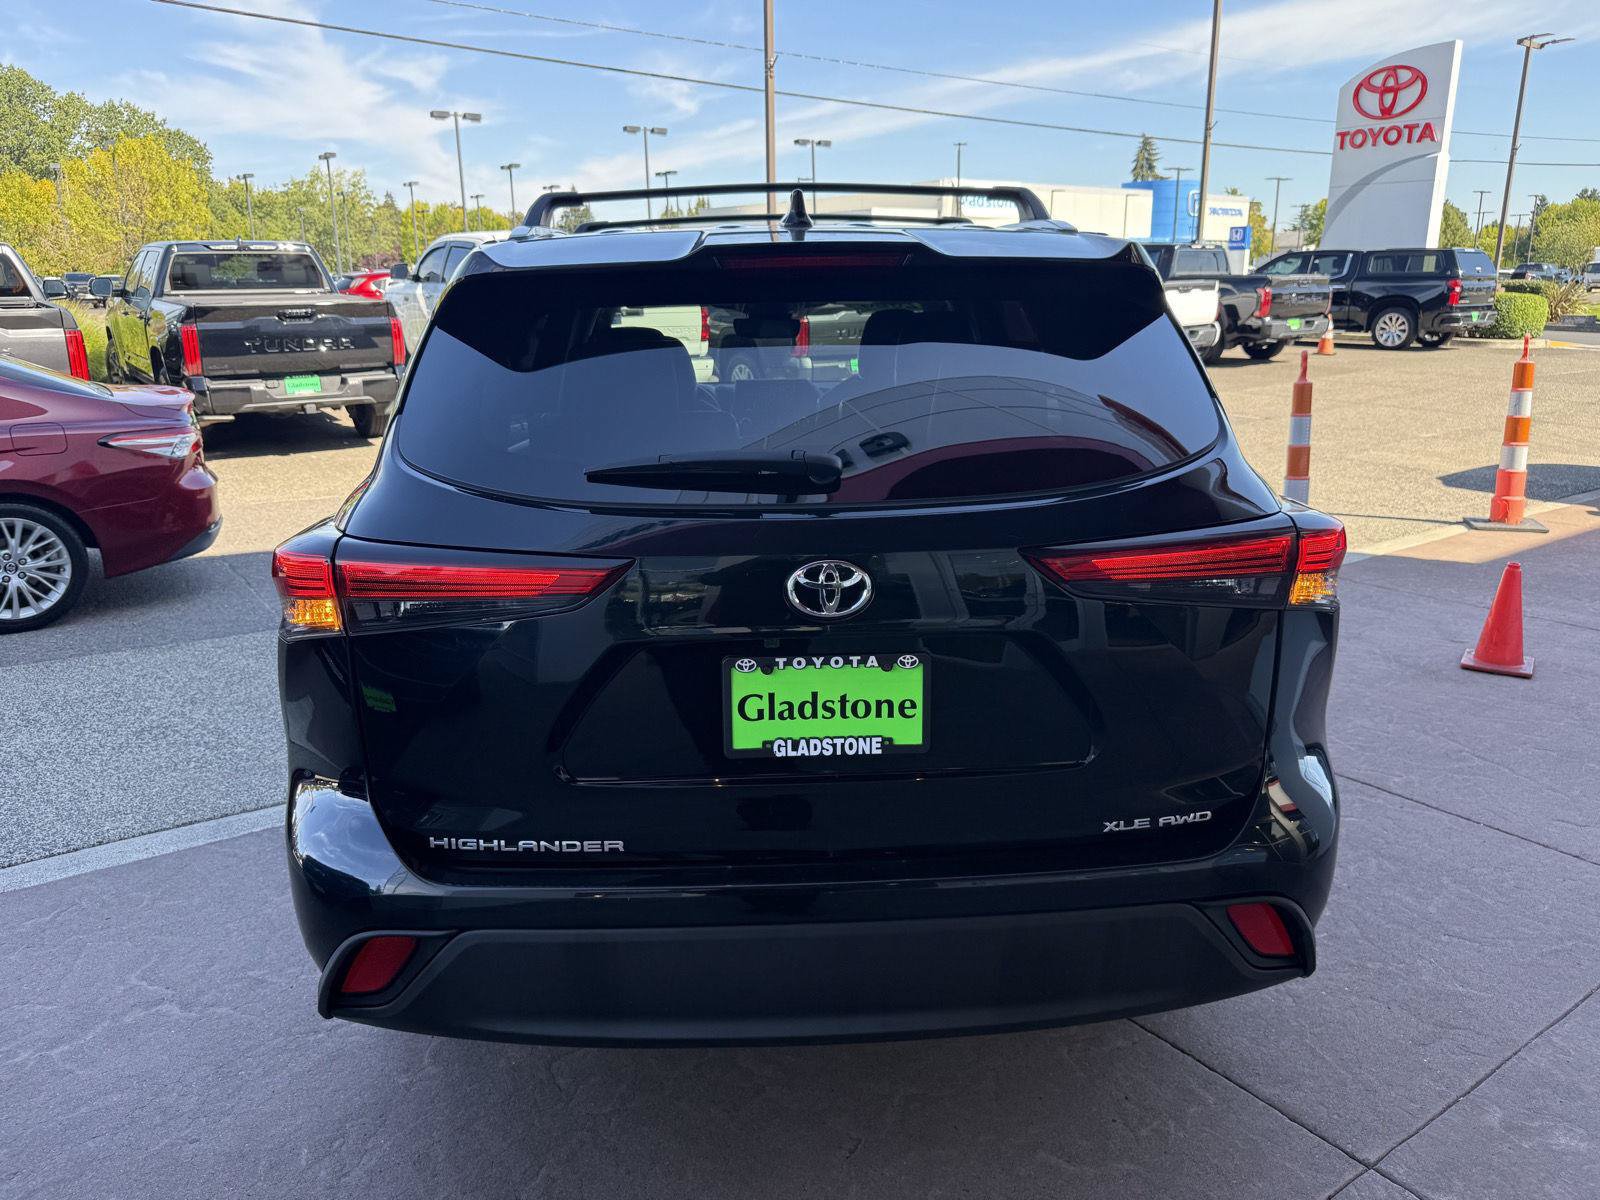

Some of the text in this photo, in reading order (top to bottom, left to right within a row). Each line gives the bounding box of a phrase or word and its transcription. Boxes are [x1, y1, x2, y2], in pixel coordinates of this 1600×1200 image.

[1336, 122, 1438, 151] TOYOTA
[243, 337, 355, 353] TUNDRA
[775, 656, 879, 670] TOYOTA
[737, 691, 918, 722] Gladstone
[773, 737, 883, 757] GLADSTONE
[1103, 810, 1212, 833] XLE AWD
[429, 836, 625, 852] HIGHLANDER
